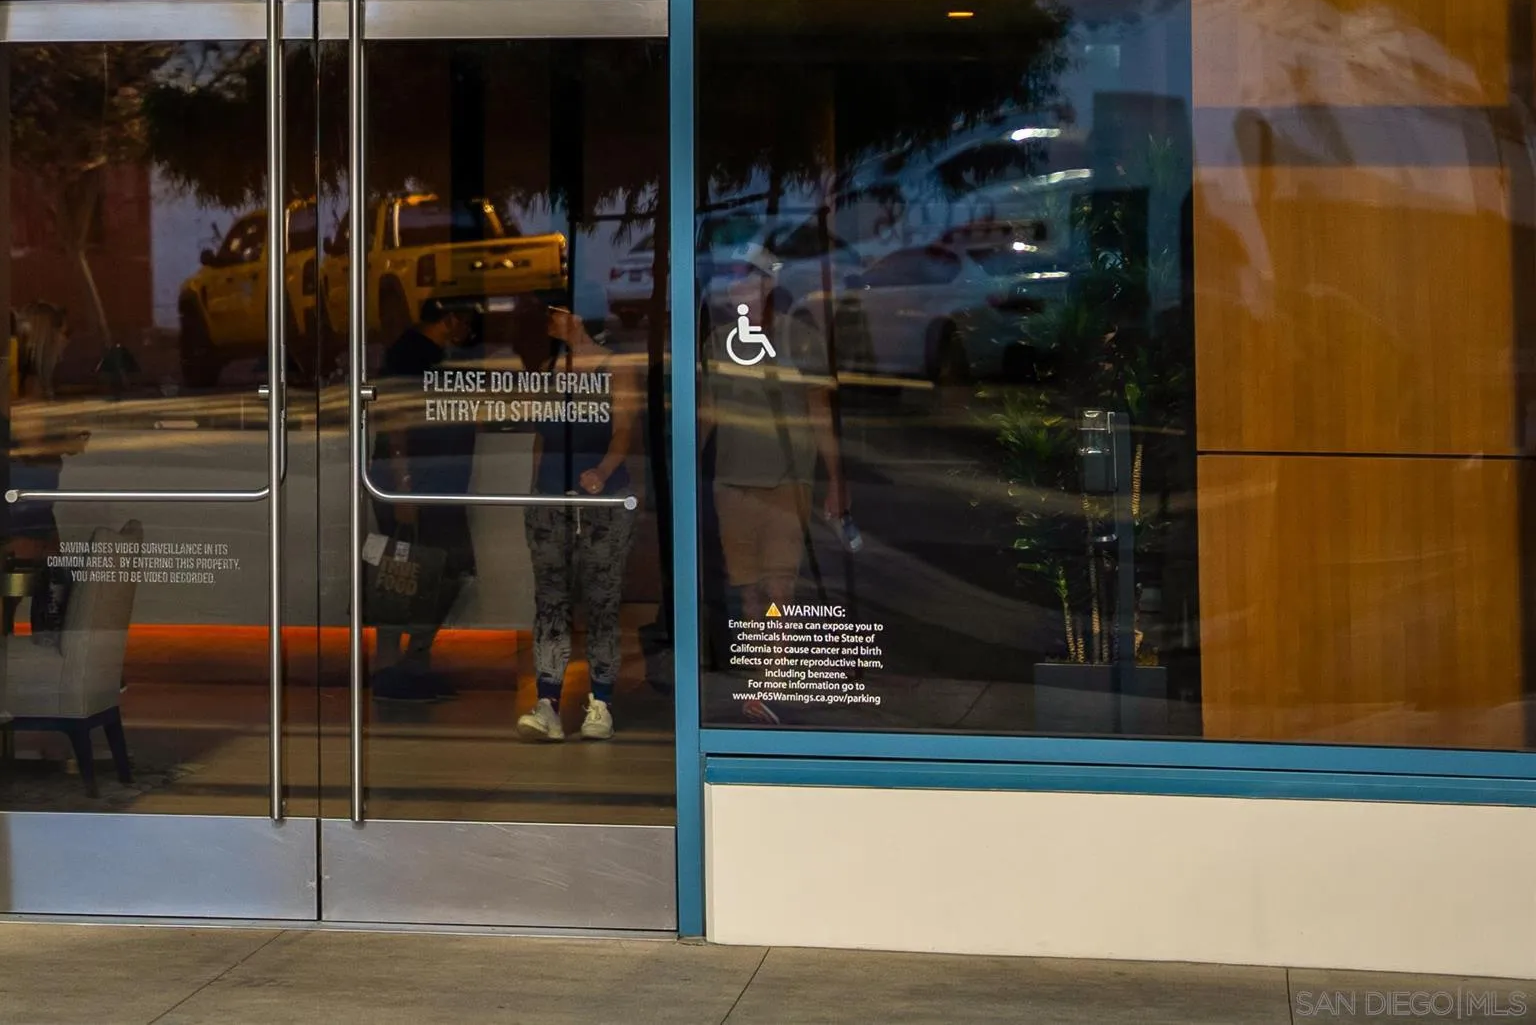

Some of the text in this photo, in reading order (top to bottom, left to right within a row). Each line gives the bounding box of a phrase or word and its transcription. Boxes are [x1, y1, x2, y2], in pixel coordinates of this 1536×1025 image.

[423, 370, 613, 394] PLEASE DO NOT GRANT
[425, 399, 610, 424] ENTRY TO STRANGERS
[60, 542, 228, 555] SAVINA USES VIDEO SURVEILLANCE IN ITS
[47, 556, 84, 567] COMMON
[86, 556, 115, 568] AREAS.
[120, 557, 131, 568] BY
[133, 557, 173, 569] ENTERING
[175, 558, 194, 569] THIS
[71, 571, 86, 582] YOU
[89, 571, 116, 582] AGREE
[118, 571, 129, 582] TO
[130, 571, 142, 583] BE
[144, 572, 167, 583] VIDEO
[782, 604, 846, 617] WARNING:
[728, 620, 883, 632] Entering this area can expose you to
[737, 632, 875, 643] chemicals known to the State of
[730, 643, 771, 653] California
[773, 645, 783, 654] to
[811, 647, 840, 655] cancer
[841, 646, 858, 655] and
[860, 646, 882, 655] birth
[730, 656, 884, 669] defects or other reproductive harm,
[765, 669, 848, 680] including benzene.
[748, 680, 762, 689] For
[789, 680, 840, 690] information
[842, 683, 854, 692] go
[855, 682, 865, 690] to
[732, 692, 881, 705] www.P65Warnings.ca.gov/parking
